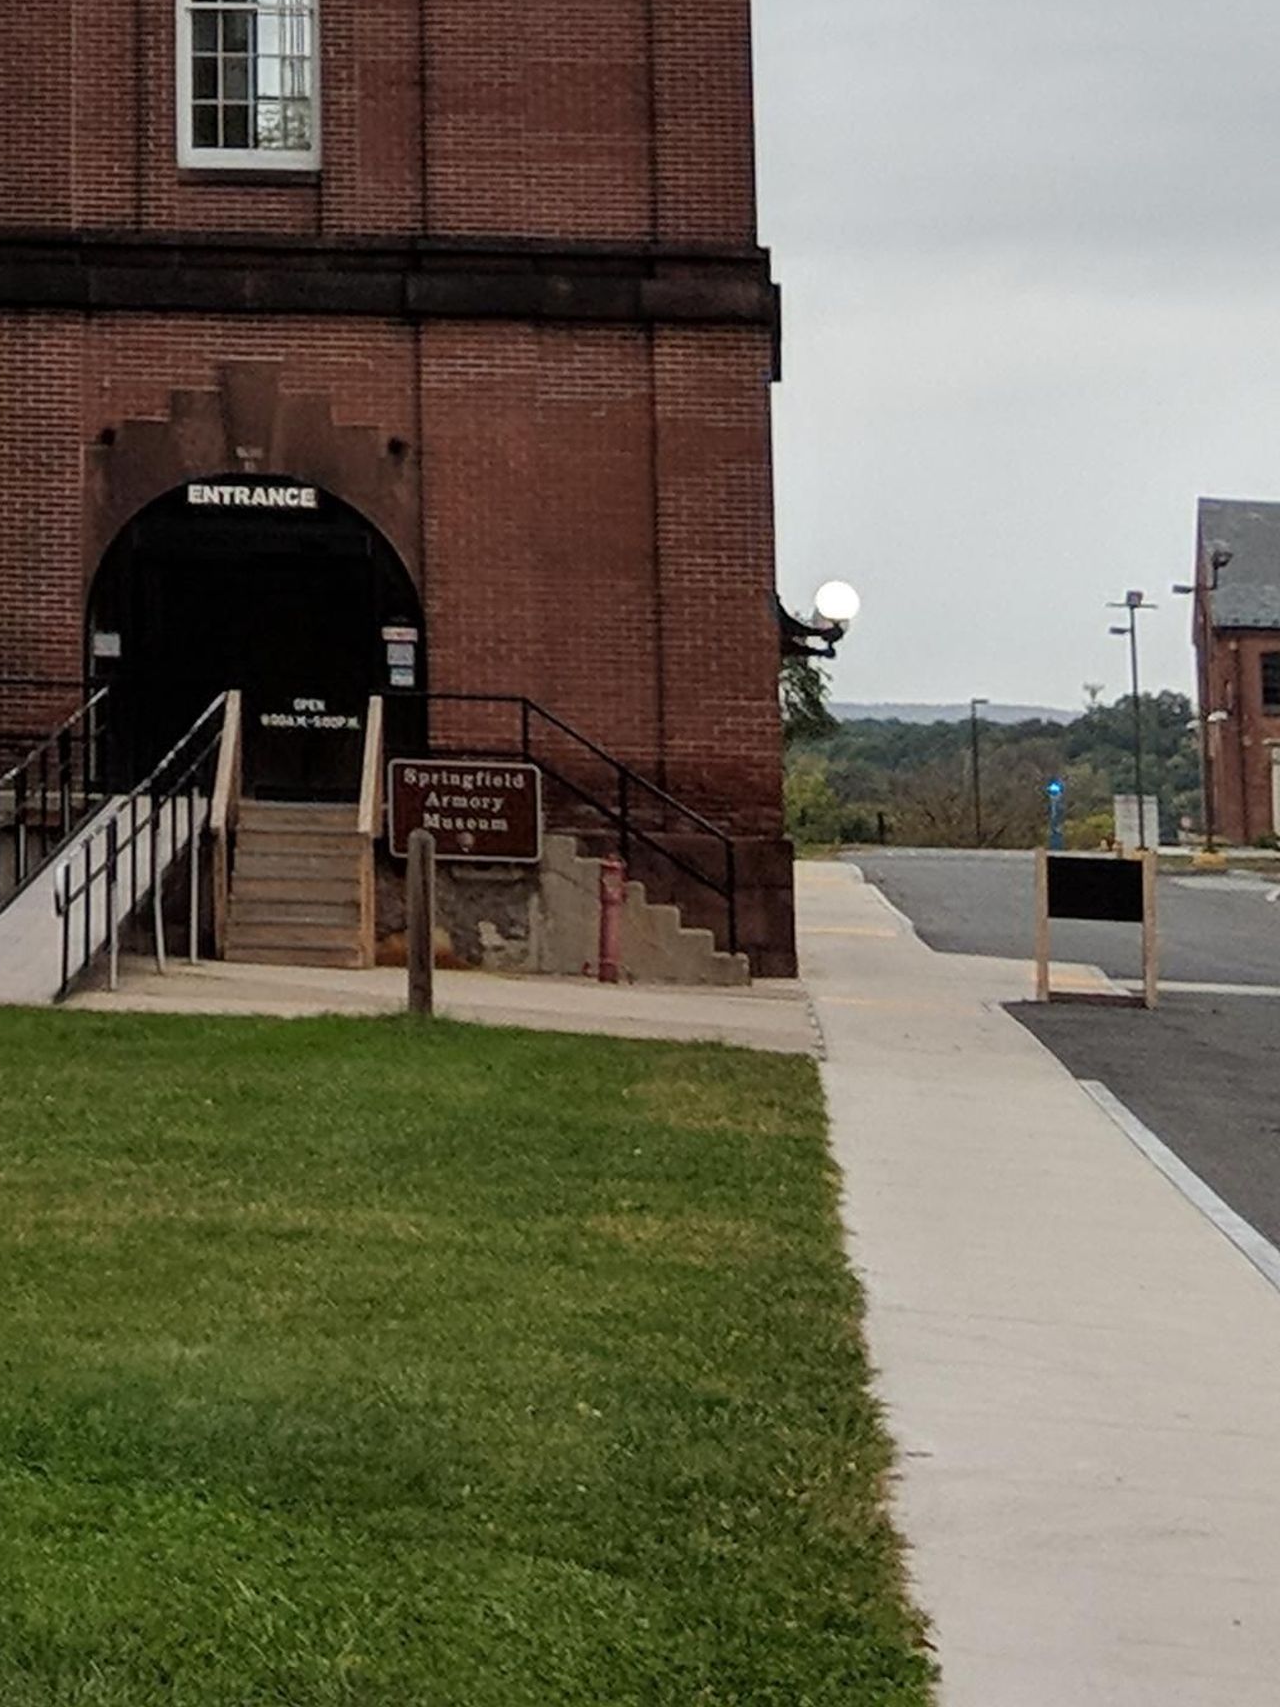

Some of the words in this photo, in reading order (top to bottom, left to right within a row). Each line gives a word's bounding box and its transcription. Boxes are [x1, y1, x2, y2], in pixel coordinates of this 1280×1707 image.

[188, 484, 317, 508] ENTRANCE
[293, 697, 327, 712] OPEN
[403, 767, 525, 790] Springfield
[424, 790, 504, 813] Armory
[422, 812, 509, 832] Museum
